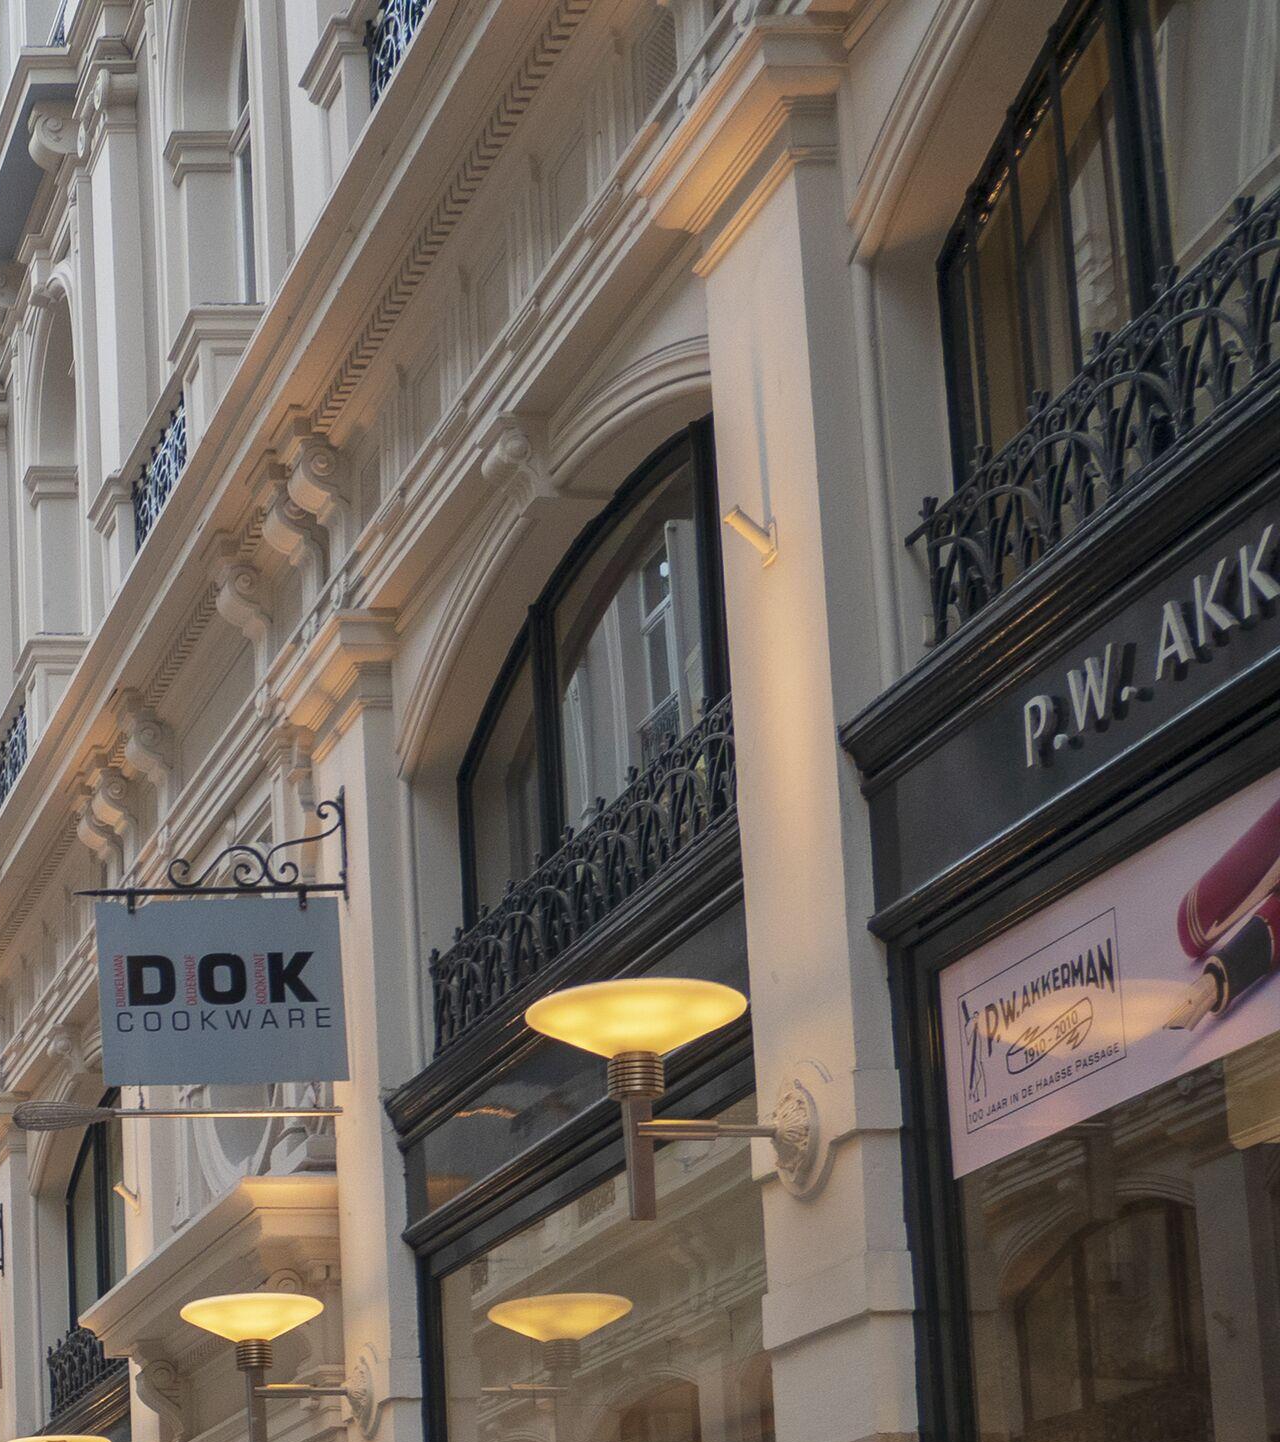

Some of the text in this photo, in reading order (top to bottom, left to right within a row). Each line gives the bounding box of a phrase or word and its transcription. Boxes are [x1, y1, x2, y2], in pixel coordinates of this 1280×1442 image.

[1024, 642, 1137, 768] P.W.
[127, 951, 318, 1007] DOK
[117, 1007, 332, 1033] COOKWARE
[986, 1095, 1009, 1119] JAAR
[1021, 1084, 1033, 1100] DE
[1035, 1064, 1073, 1092] HAAGSE
